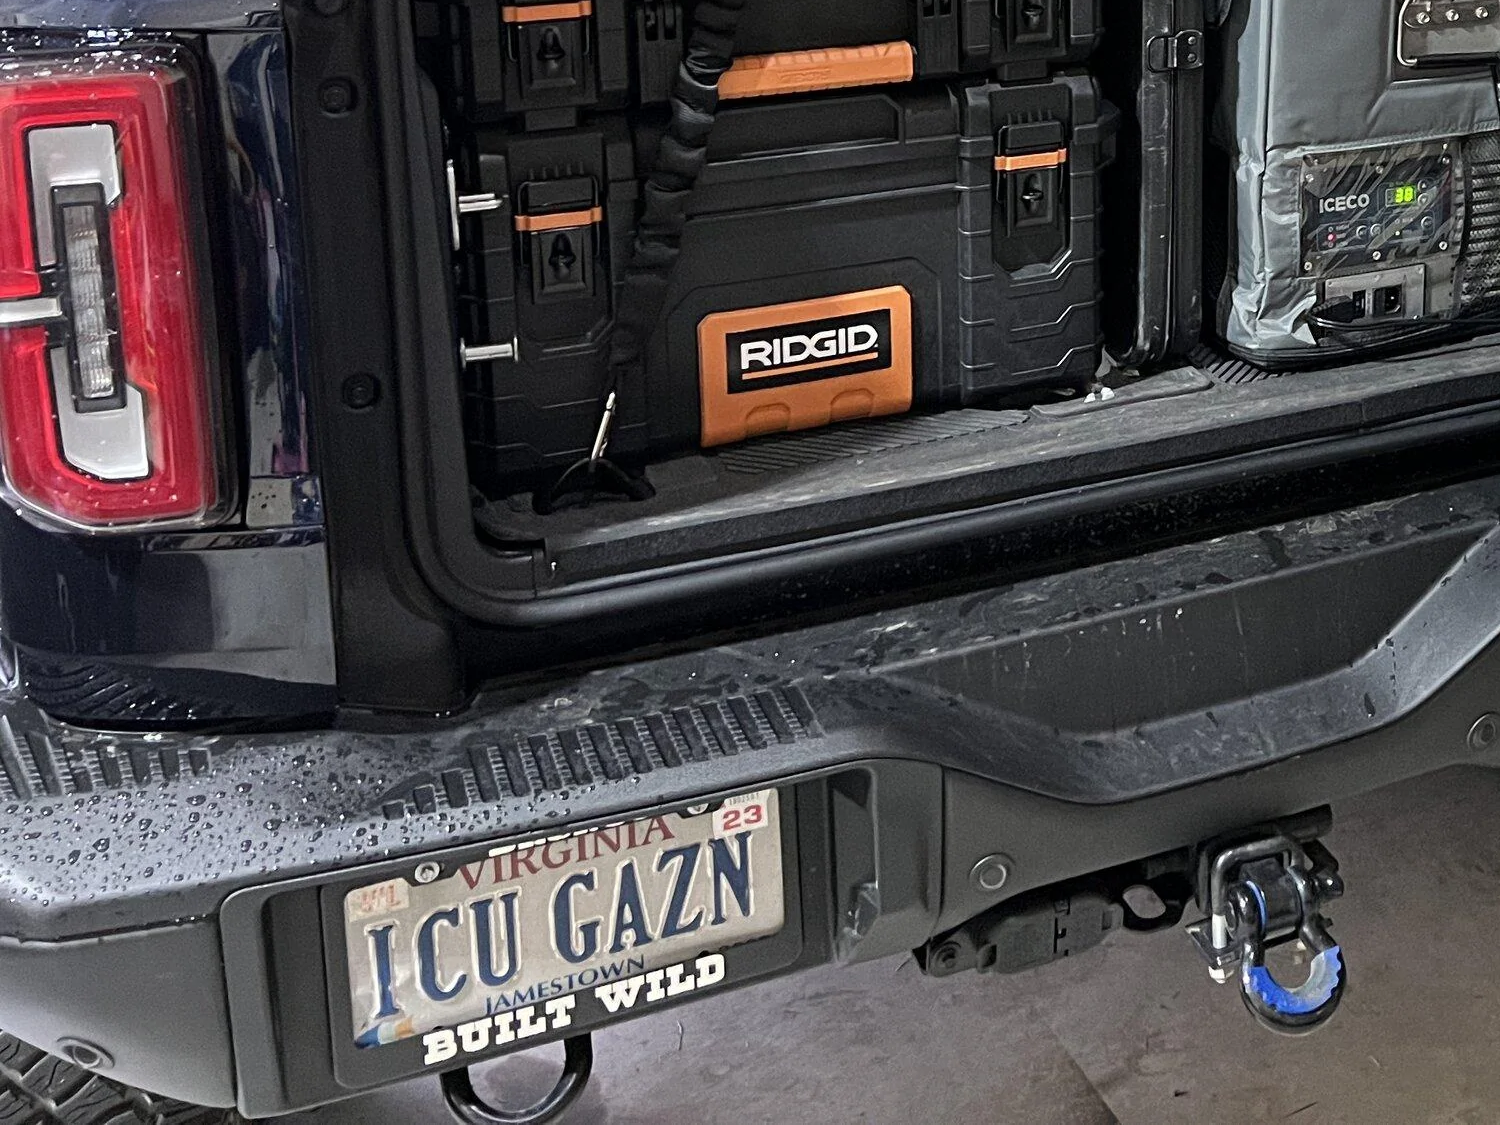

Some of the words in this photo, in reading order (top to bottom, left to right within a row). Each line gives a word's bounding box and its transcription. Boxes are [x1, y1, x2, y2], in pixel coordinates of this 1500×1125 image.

[1319, 193, 1370, 214] ICECO
[740, 324, 878, 370] RIDGID
[723, 804, 763, 831] 23
[459, 815, 675, 889] VIRGINIA
[366, 889, 521, 1019] ICU
[551, 830, 753, 965] GAZN
[423, 993, 576, 1066] BUILT
[595, 952, 726, 1013] WILD
[485, 953, 647, 1016] JAMESTOWN
